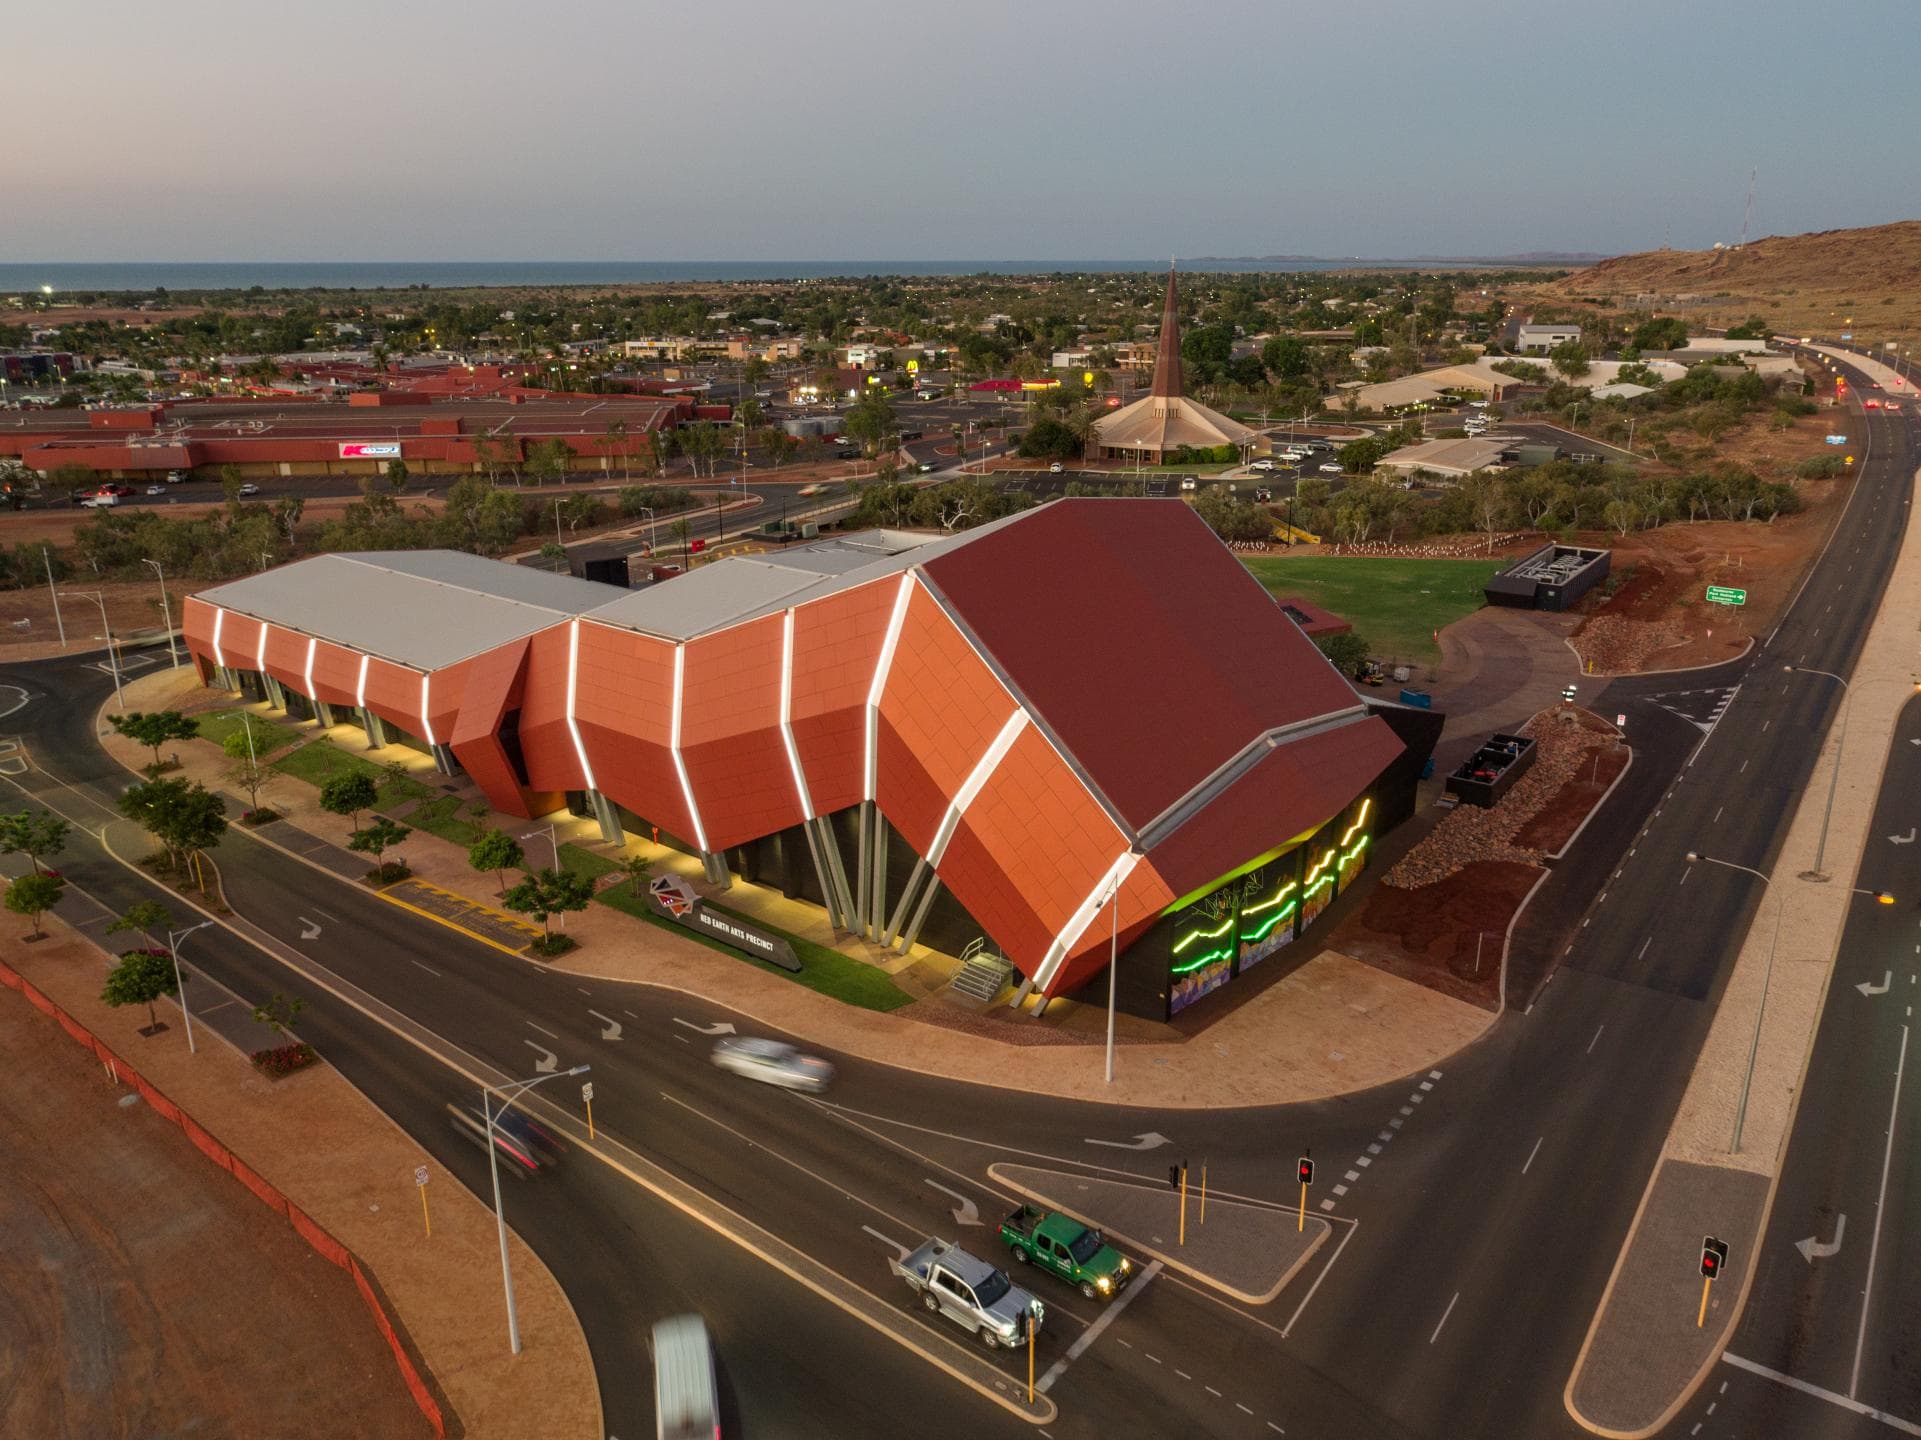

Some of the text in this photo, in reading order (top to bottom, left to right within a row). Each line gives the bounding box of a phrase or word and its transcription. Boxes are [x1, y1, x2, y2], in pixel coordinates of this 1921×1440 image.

[712, 918, 730, 933] EARTH
[730, 926, 745, 939] ARTS
[746, 932, 774, 952] PRECINCT
